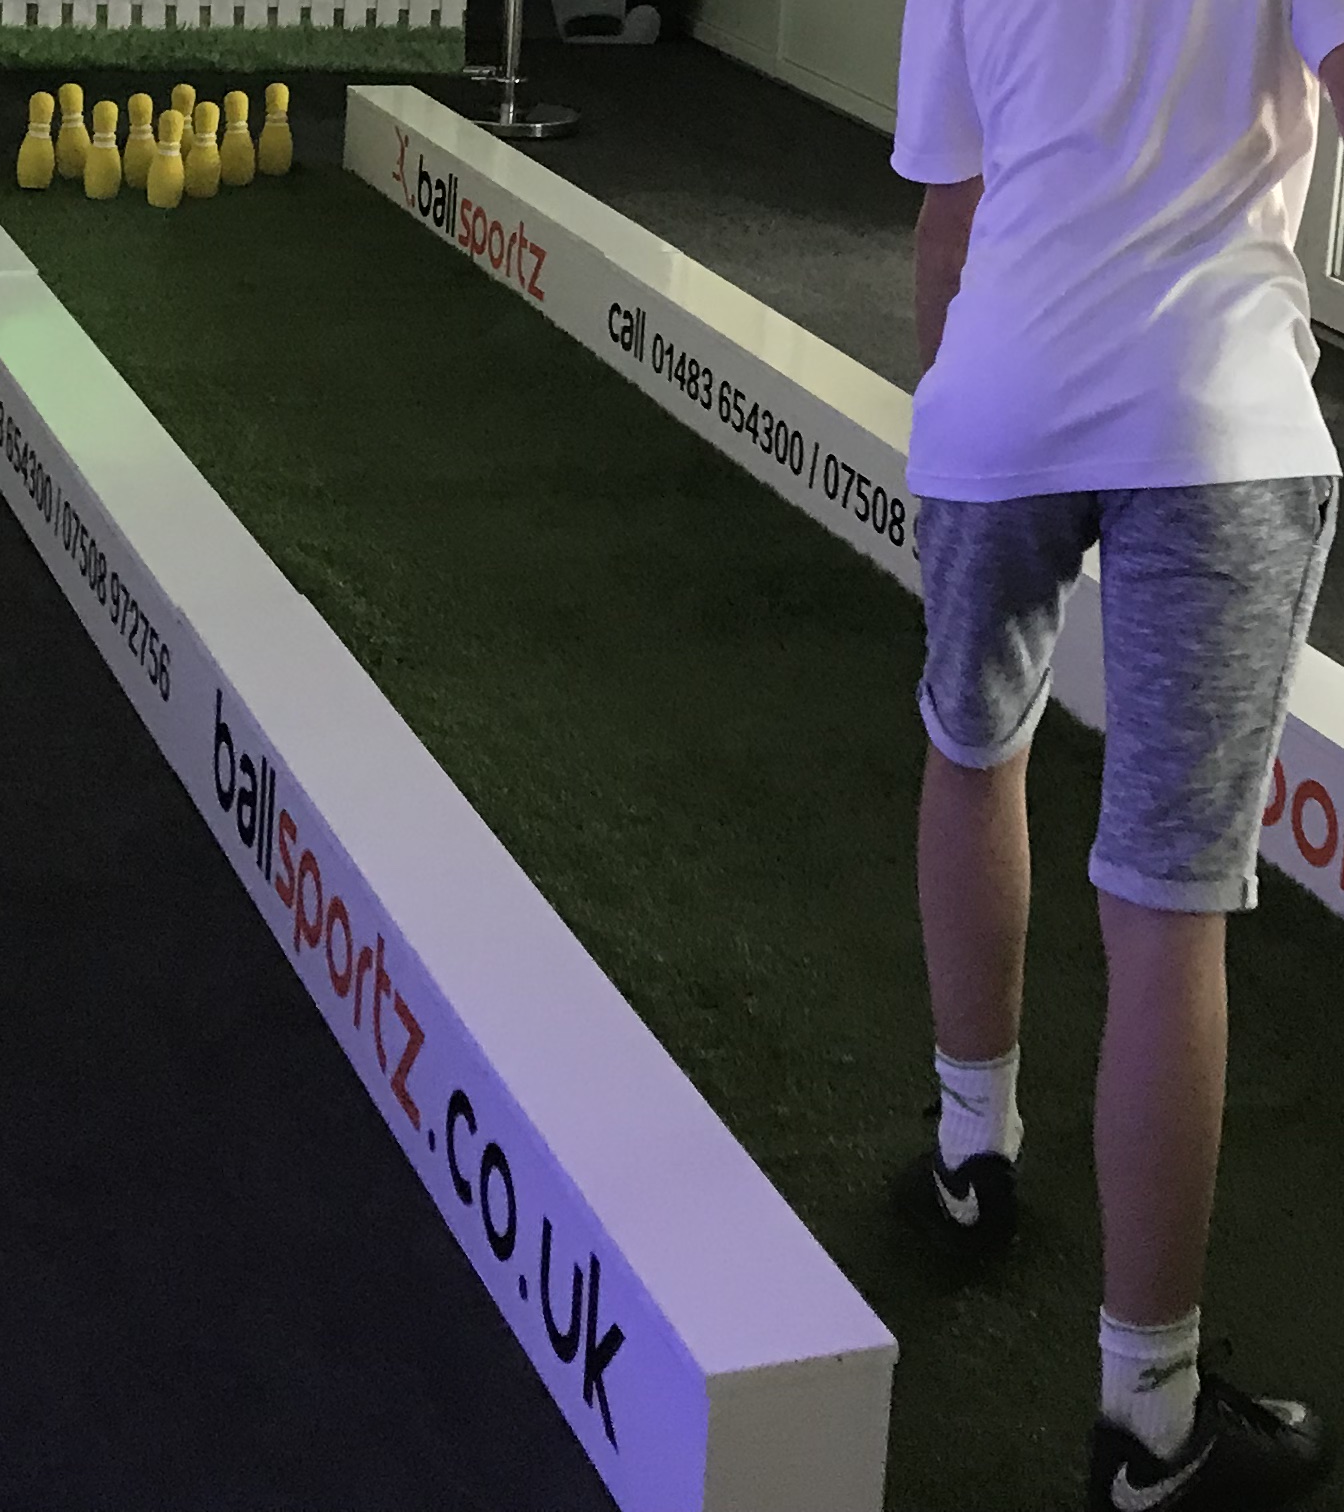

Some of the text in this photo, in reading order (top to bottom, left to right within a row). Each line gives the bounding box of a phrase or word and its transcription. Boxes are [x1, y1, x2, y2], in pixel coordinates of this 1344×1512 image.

[418, 154, 547, 302] ballsportz
[608, 301, 647, 364] call
[651, 333, 713, 411] 01483
[718, 380, 805, 476] 654300
[823, 453, 906, 547] 07508
[6, 415, 53, 524] 654300
[61, 499, 107, 607] 07508
[108, 571, 171, 702] 972756
[213, 688, 627, 1455] ballsportz.co.uk
